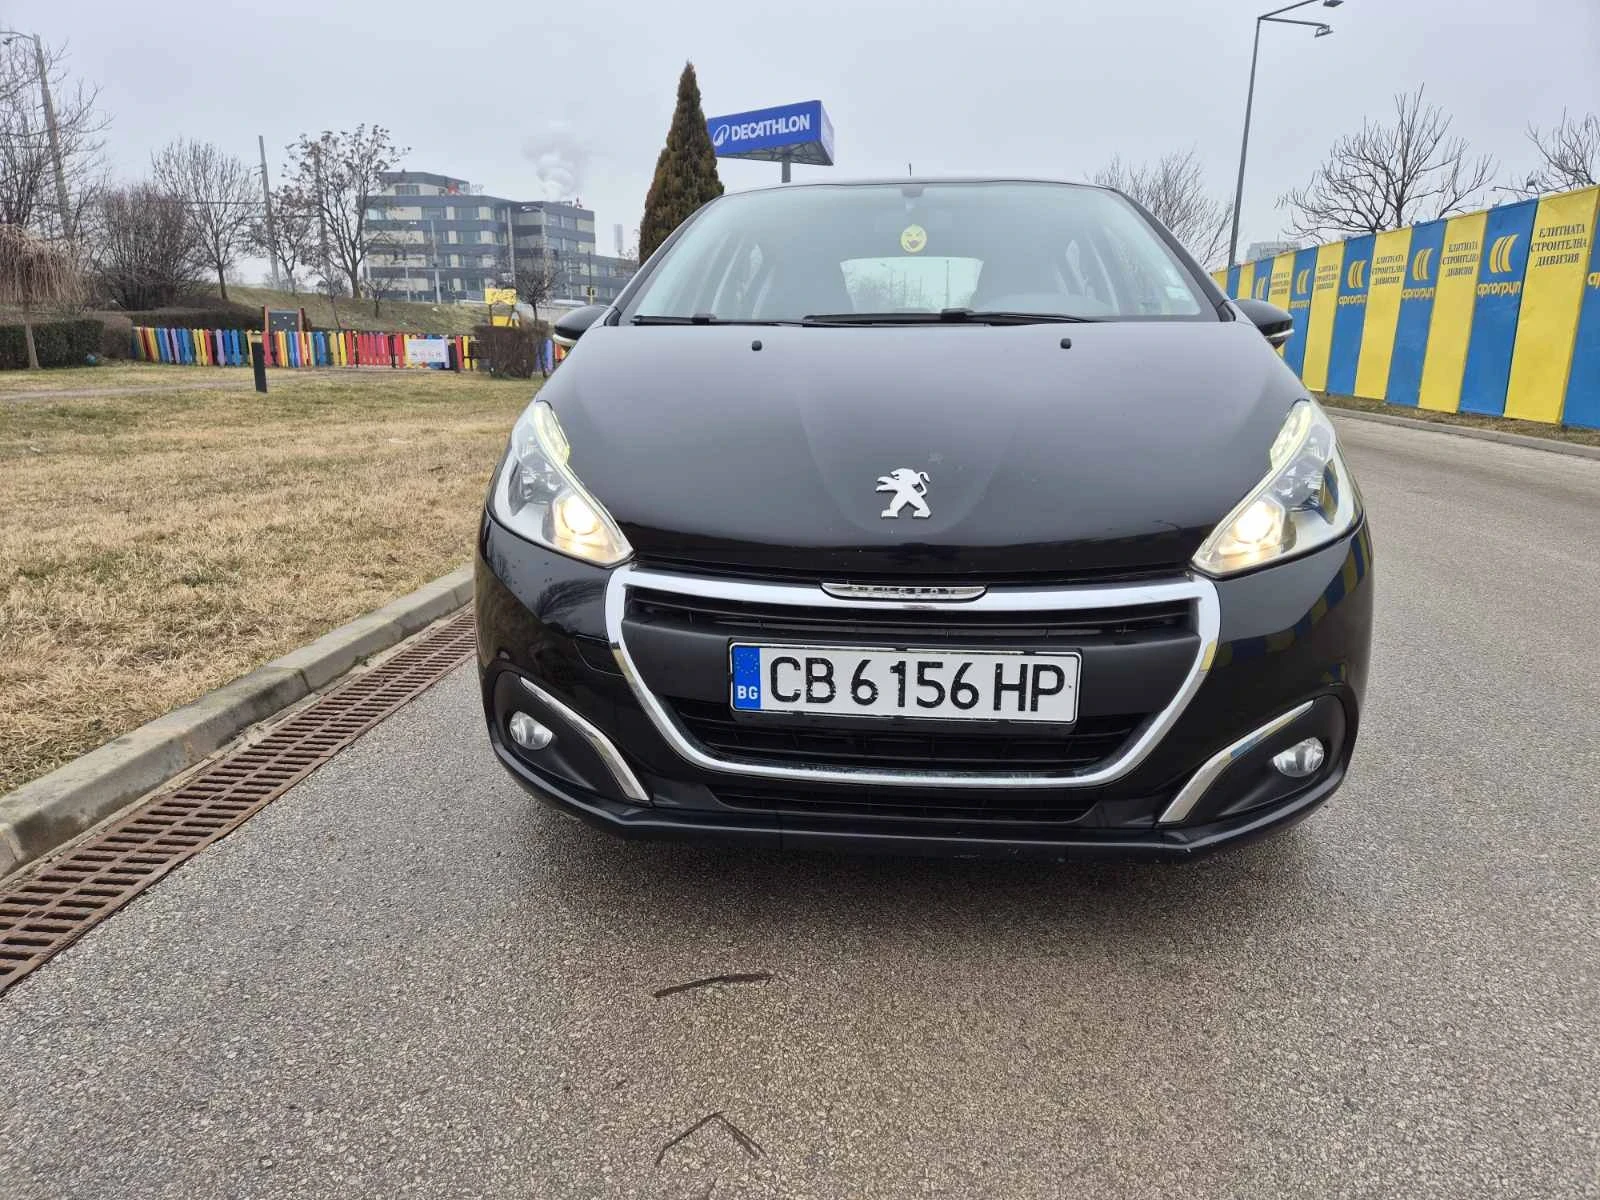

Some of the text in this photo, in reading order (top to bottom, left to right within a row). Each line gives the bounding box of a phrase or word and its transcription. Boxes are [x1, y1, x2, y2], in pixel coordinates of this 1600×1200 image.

[731, 114, 811, 141] DECATHLON
[1539, 224, 1585, 238] ЕЛИТНАТА
[1531, 238, 1587, 253] СТРОИТЕЛНА
[1535, 253, 1580, 268] ДИВИЗИЯ
[737, 656, 1066, 712] BG CB 6156 HP
